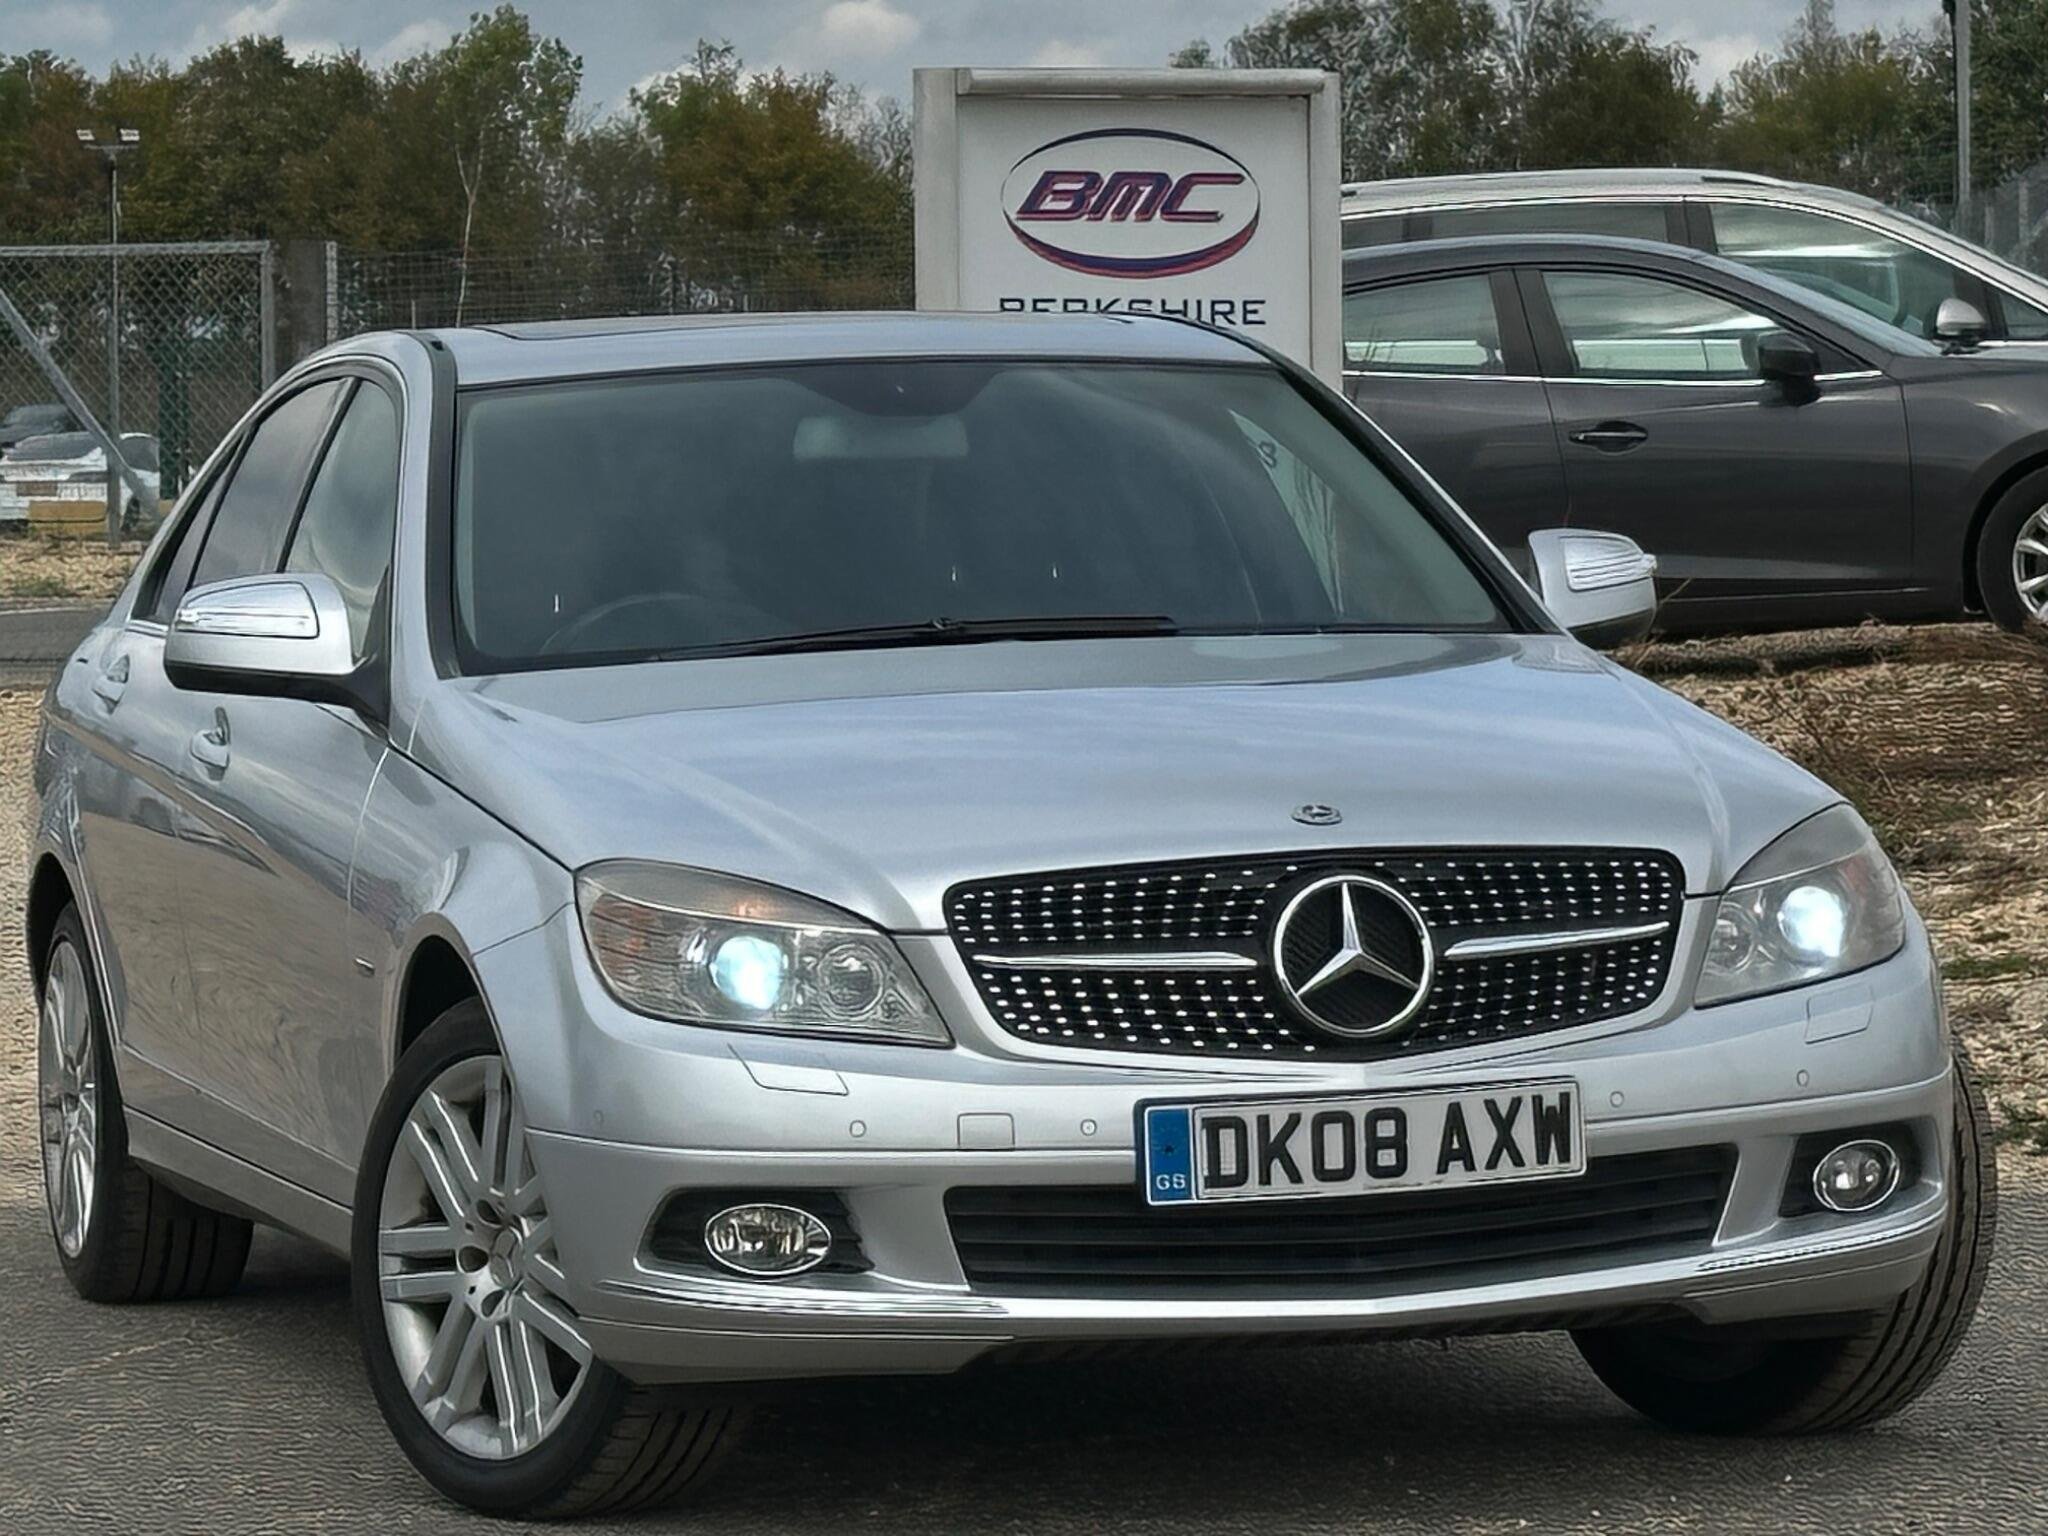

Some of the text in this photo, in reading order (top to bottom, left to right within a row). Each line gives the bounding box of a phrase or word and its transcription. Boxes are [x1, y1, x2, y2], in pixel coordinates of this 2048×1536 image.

[1016, 170, 1245, 222] BMC
[1202, 1092, 1571, 1189] DK08 AXW
